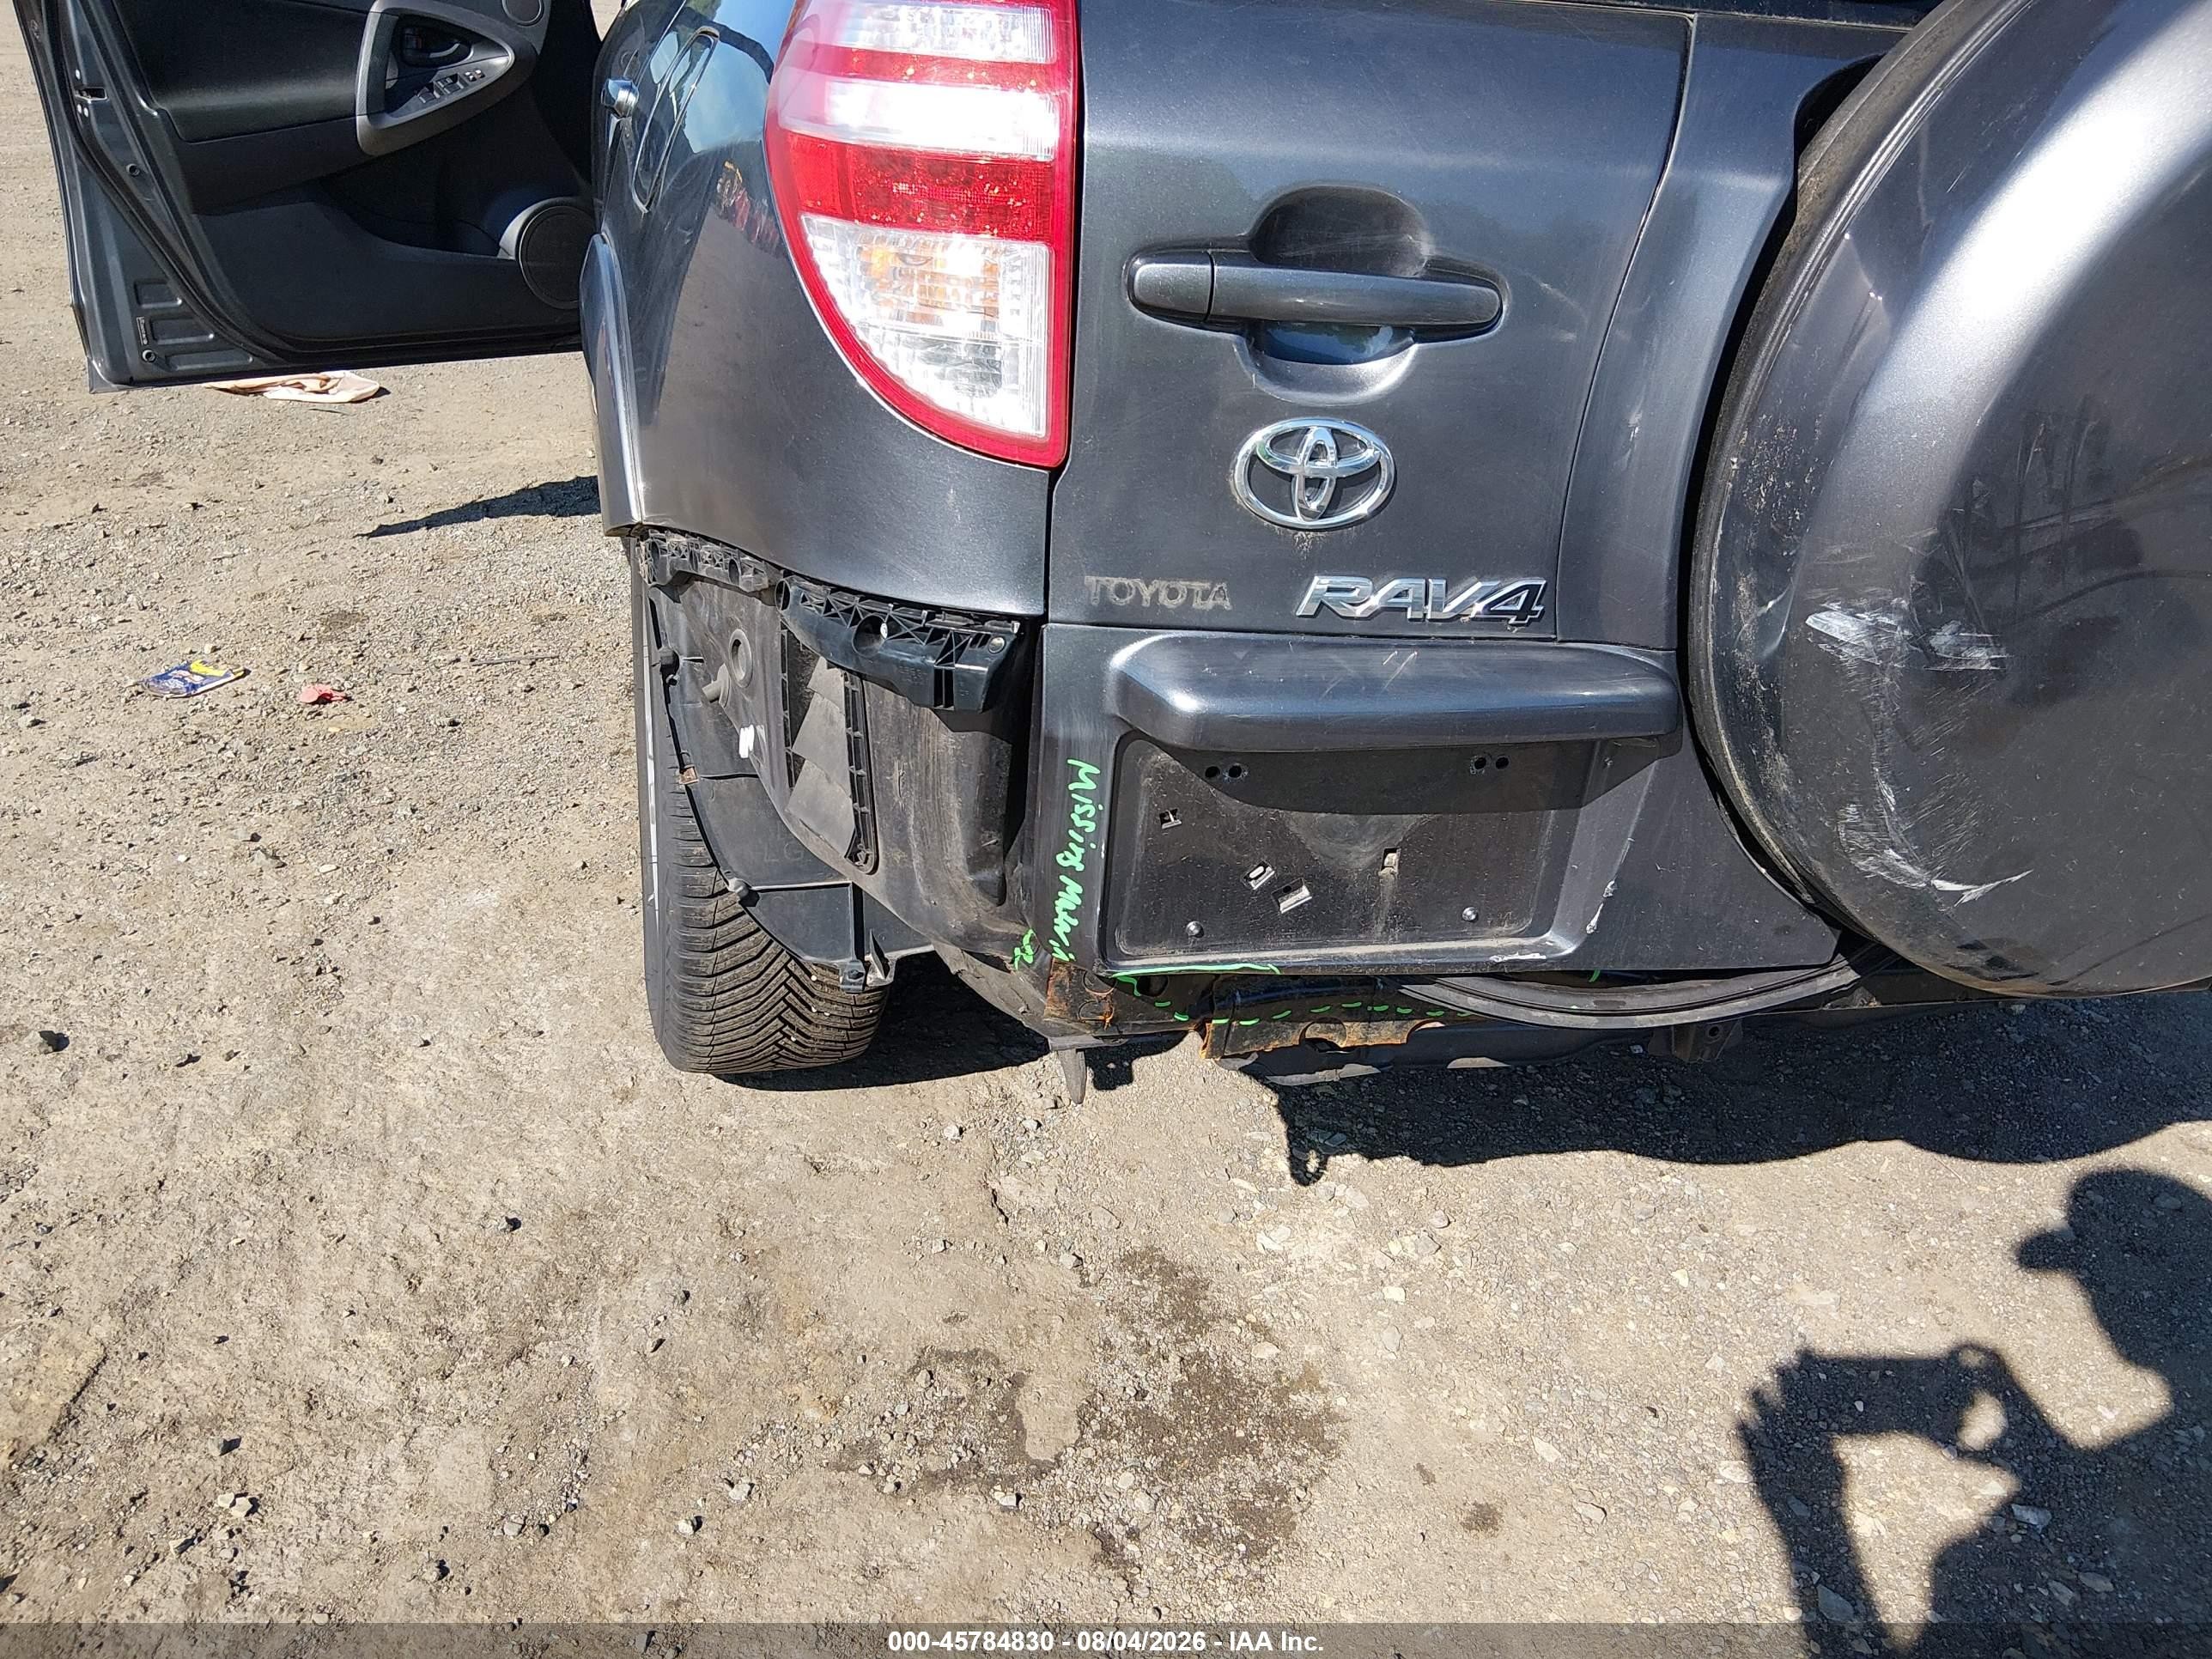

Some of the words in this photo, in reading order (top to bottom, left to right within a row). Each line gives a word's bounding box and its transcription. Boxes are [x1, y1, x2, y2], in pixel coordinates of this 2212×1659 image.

[1085, 575, 1232, 611] TOYOTA
[1296, 575, 1547, 624] RAV4
[1056, 758, 1104, 872] Missing
